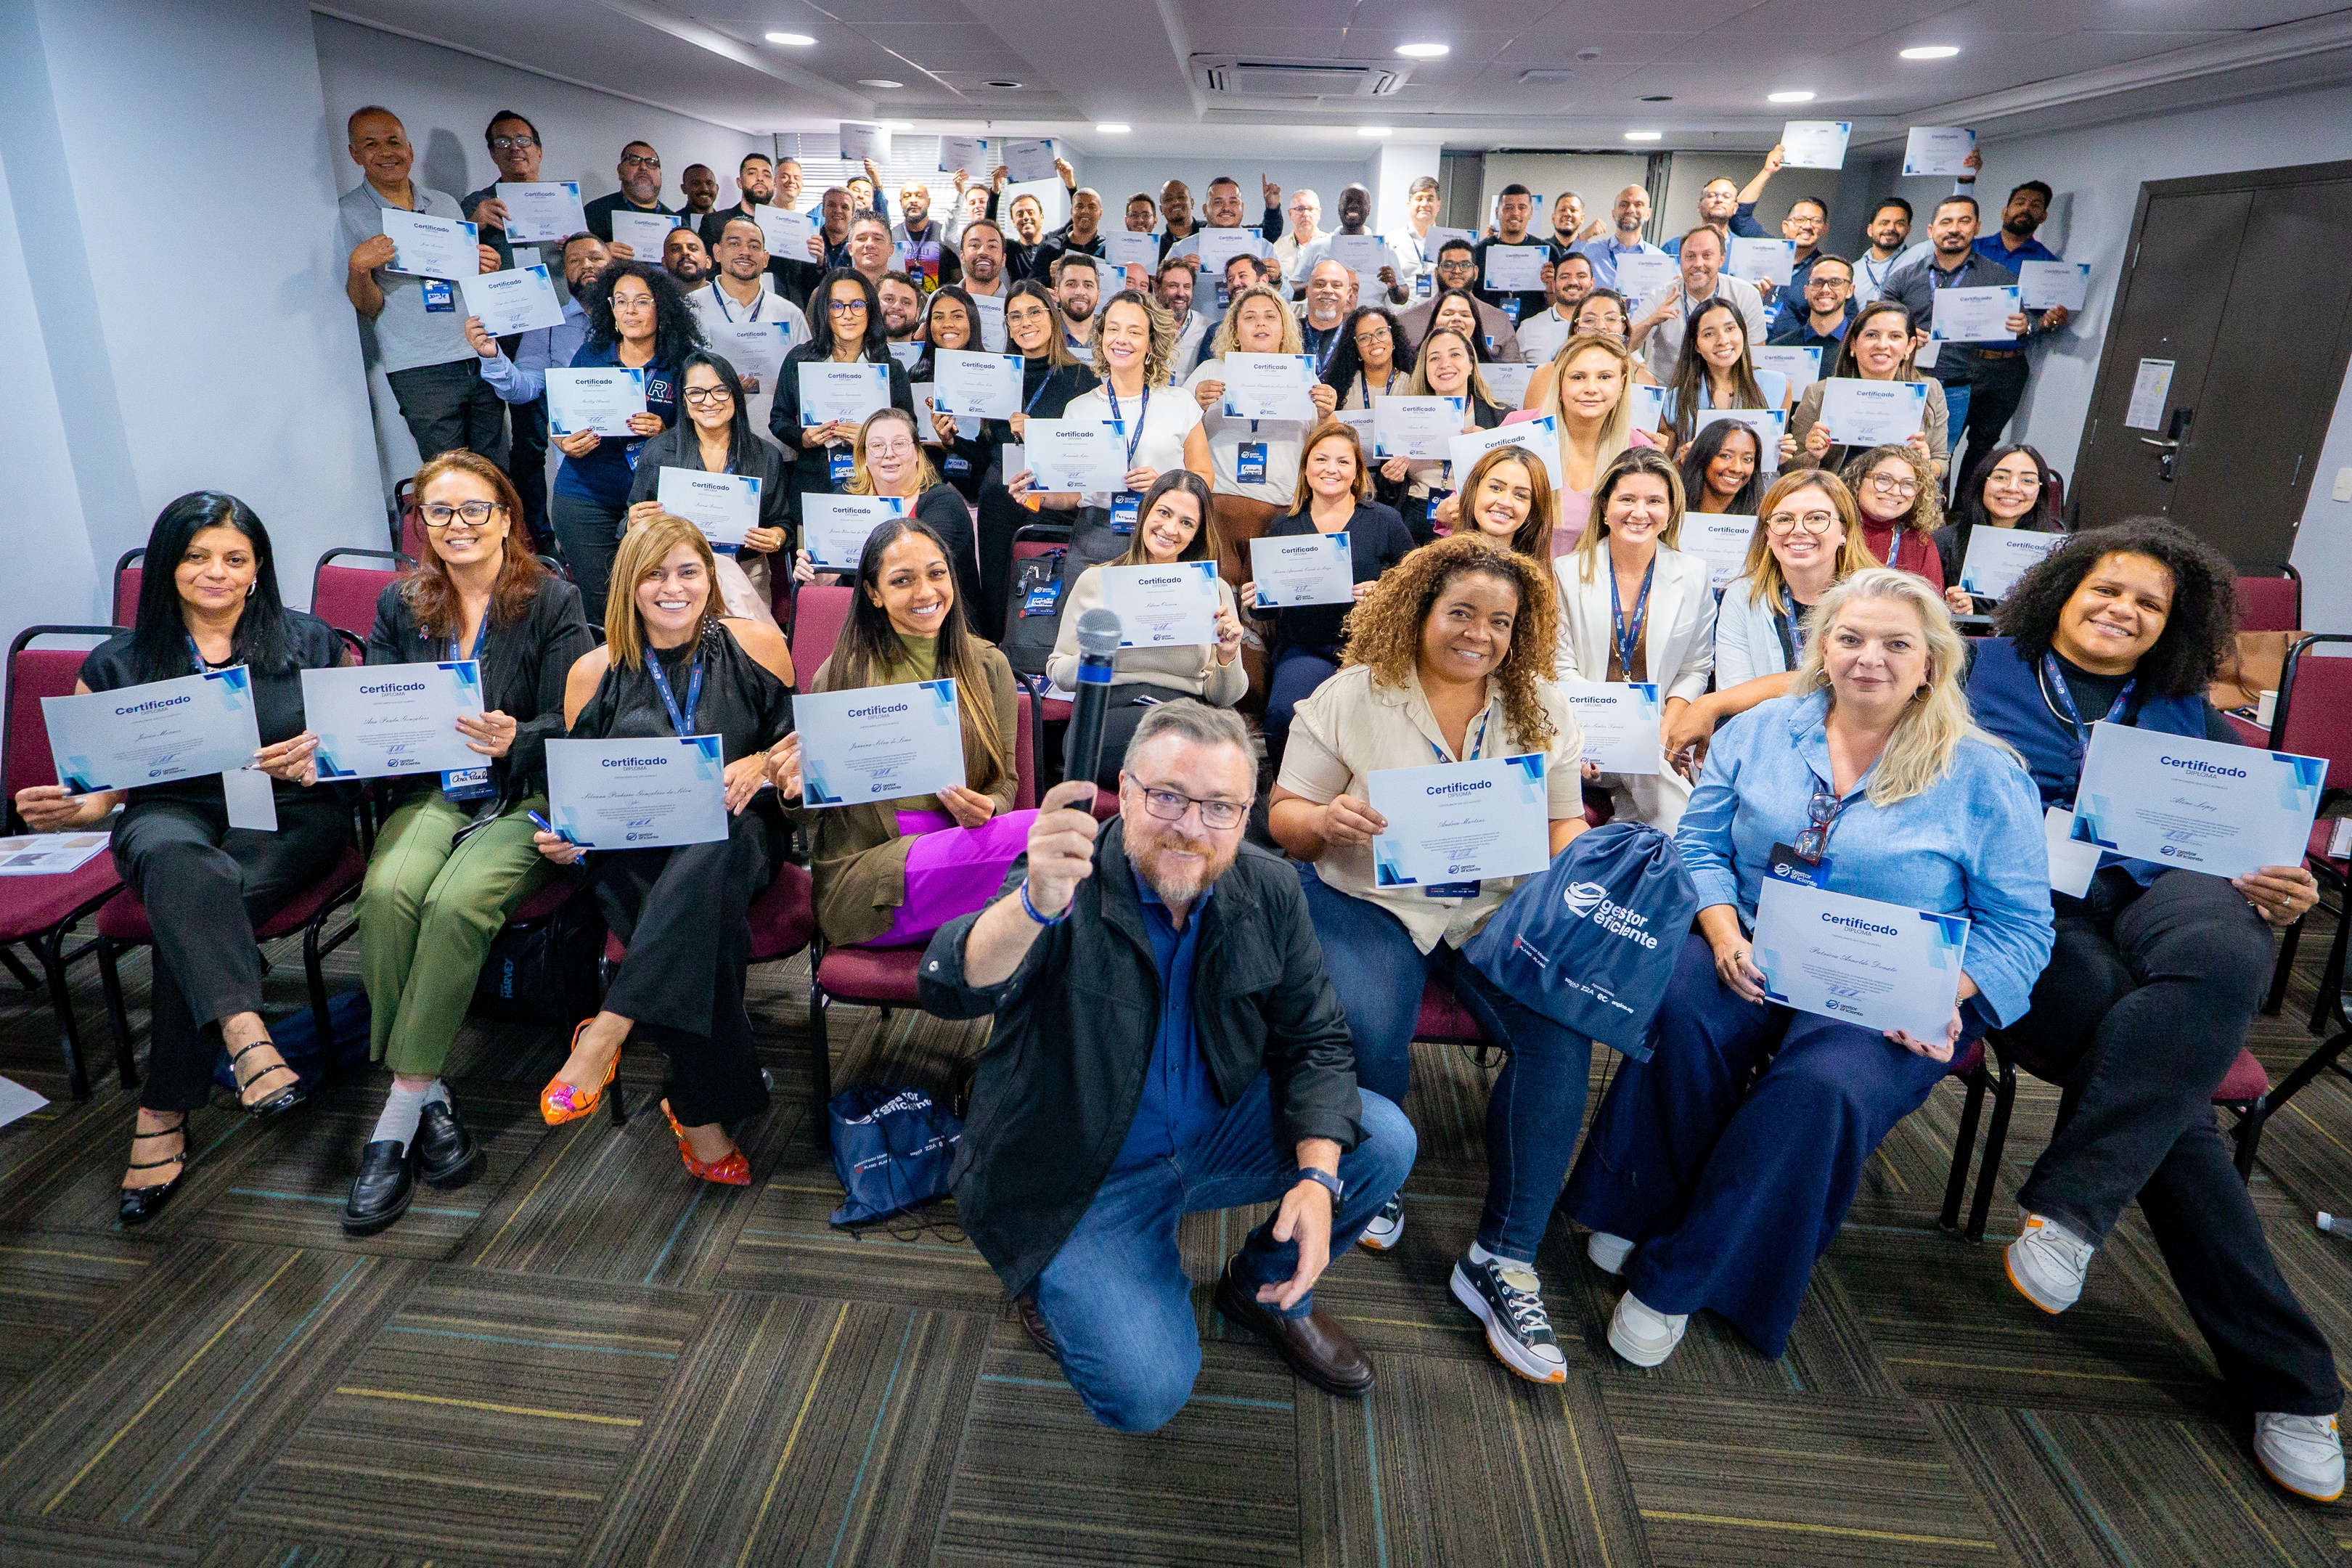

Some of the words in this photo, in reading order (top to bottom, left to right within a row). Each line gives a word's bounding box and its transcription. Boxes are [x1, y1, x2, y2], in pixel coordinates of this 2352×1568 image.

[414, 223, 449, 233] Certificado
[488, 279, 522, 290] Certificado
[1485, 436, 1525, 449] Certificado
[692, 481, 730, 491] Certificado
[1138, 576, 1182, 585] Certificado
[359, 682, 425, 695] Certificado
[115, 695, 191, 715] Certificado
[848, 703, 908, 718] Certificado
[602, 757, 667, 768] Certificado
[2160, 756, 2247, 778] Certificado
[2186, 769, 2217, 779] DIPLOMA
[1426, 780, 1492, 795] Certificado
[1791, 869, 1812, 879] gestor
[1789, 875, 1818, 887] eficiente
[1598, 897, 1648, 928] gestor
[1821, 912, 1898, 936] Certificado
[1593, 912, 1658, 950] eficiente
[1844, 926, 1871, 936] DIPLOMA
[503, 958, 513, 998] HARVEY
[1580, 985, 1594, 995] Z2A
